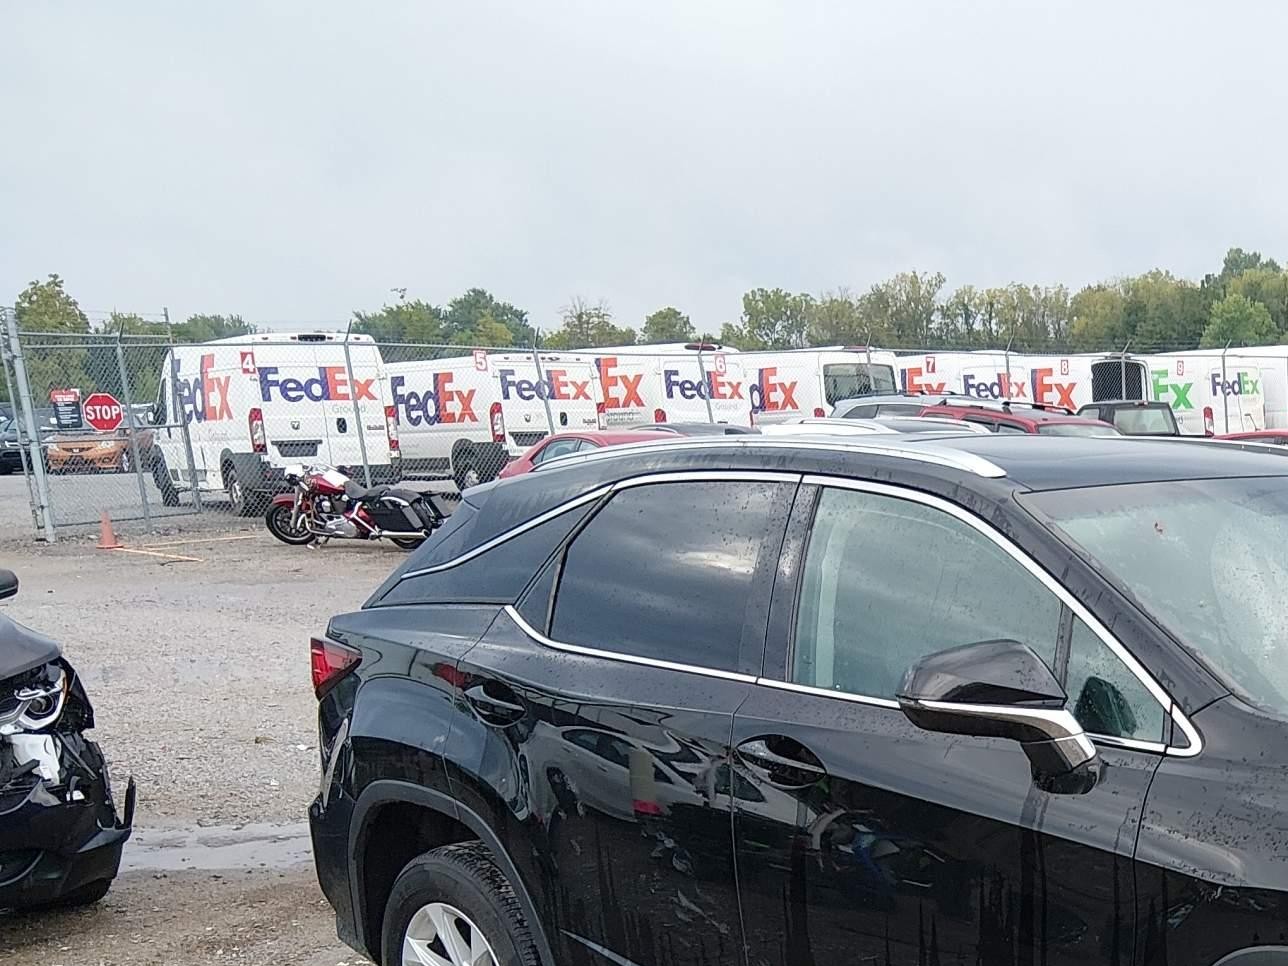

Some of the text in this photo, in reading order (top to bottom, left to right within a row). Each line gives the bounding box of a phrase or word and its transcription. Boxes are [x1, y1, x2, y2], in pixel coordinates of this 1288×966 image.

[241, 353, 256, 374] 4
[475, 352, 488, 371] 5
[926, 356, 936, 373] 7
[257, 367, 378, 402] FedEx
[499, 369, 592, 400] FedEx
[664, 369, 744, 400] FedEx
[963, 372, 1027, 399] FedEx
[1211, 372, 1260, 396] FedEx
[390, 372, 478, 426] FedEx
[86, 405, 119, 420] STOP
